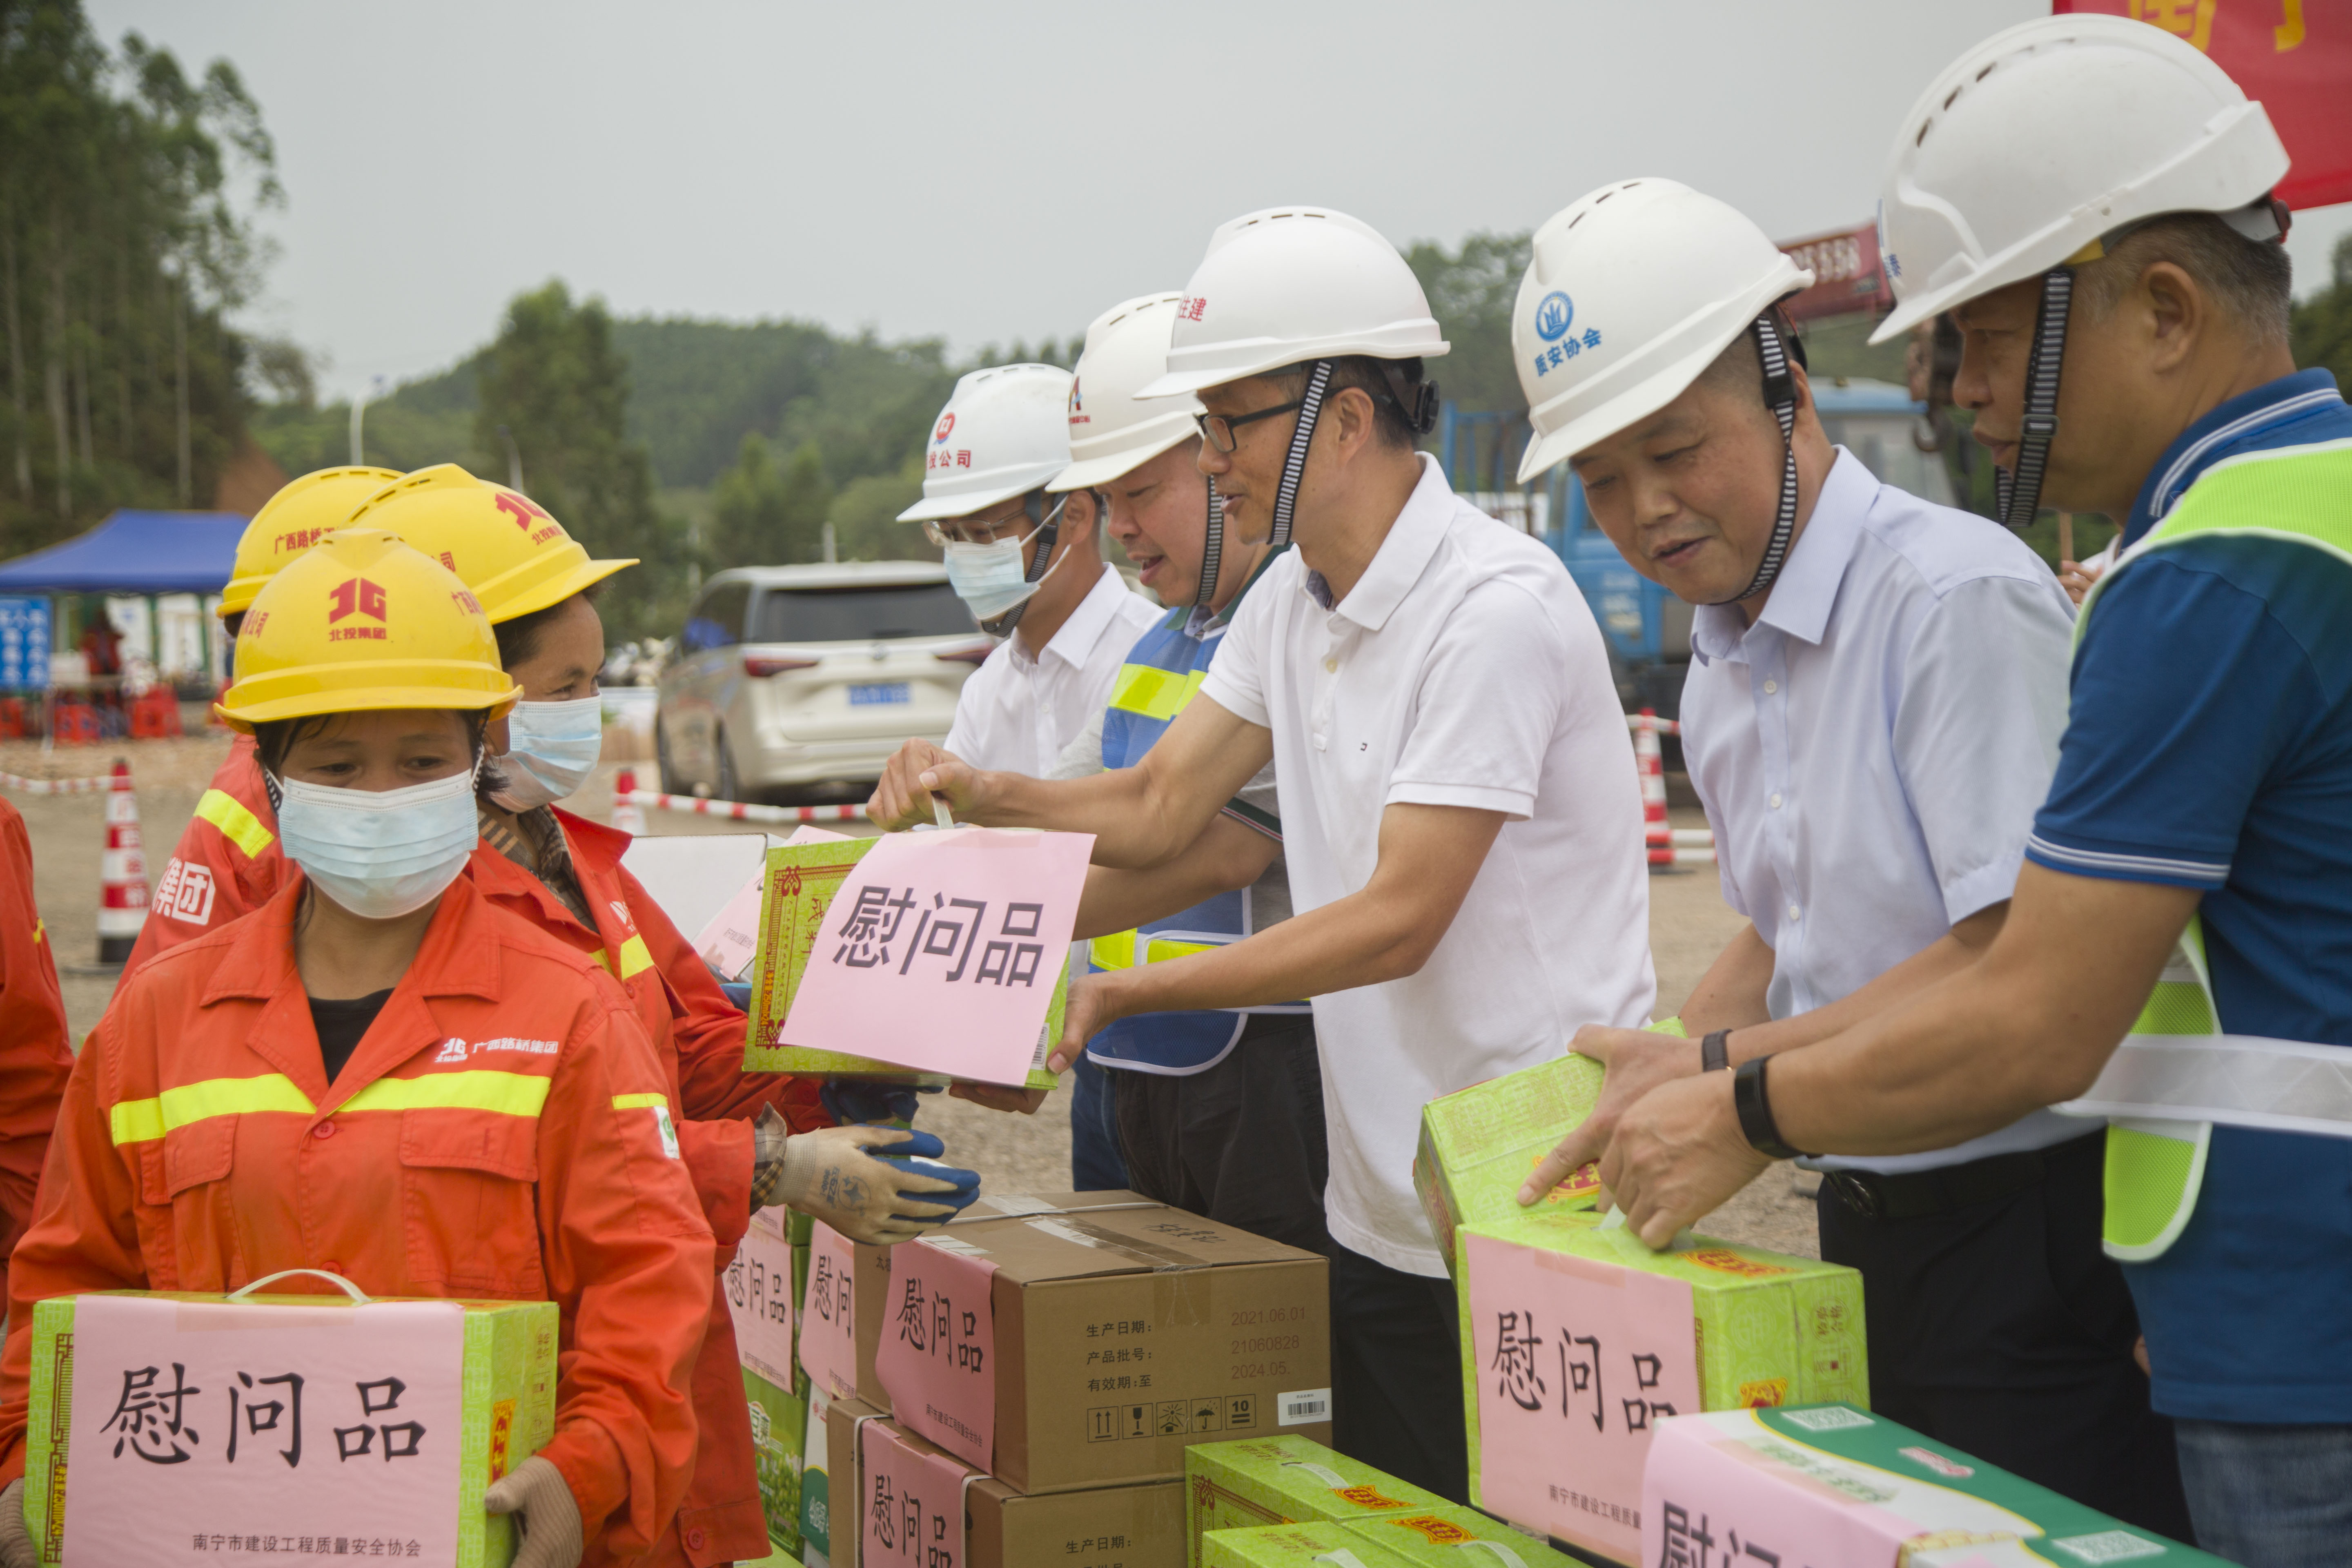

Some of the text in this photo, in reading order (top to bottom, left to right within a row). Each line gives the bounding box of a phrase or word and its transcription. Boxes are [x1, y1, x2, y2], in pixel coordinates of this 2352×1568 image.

[1534, 327, 1602, 377] 质安协会
[328, 627, 386, 642] 北投集团
[832, 885, 1045, 987] 慰问品
[472, 1037, 559, 1054] 广西路桥集团
[812, 1254, 852, 1339] 慰问
[896, 1278, 984, 1374] 慰问品
[1086, 1306, 1305, 1338] 生产日期： 2021.06.01
[1087, 1335, 1300, 1365] 产品批号： 21060828
[1231, 1361, 1291, 1380] 2024.05.
[1491, 1310, 1678, 1434] 慰问品
[99, 1362, 427, 1468] 慰问品
[1232, 1400, 1250, 1412] 10
[871, 1474, 952, 1568] 慰问品
[192, 1533, 422, 1557] 南宁市建设工程质量安全协会
[1065, 1535, 1131, 1554] 生产日期：
